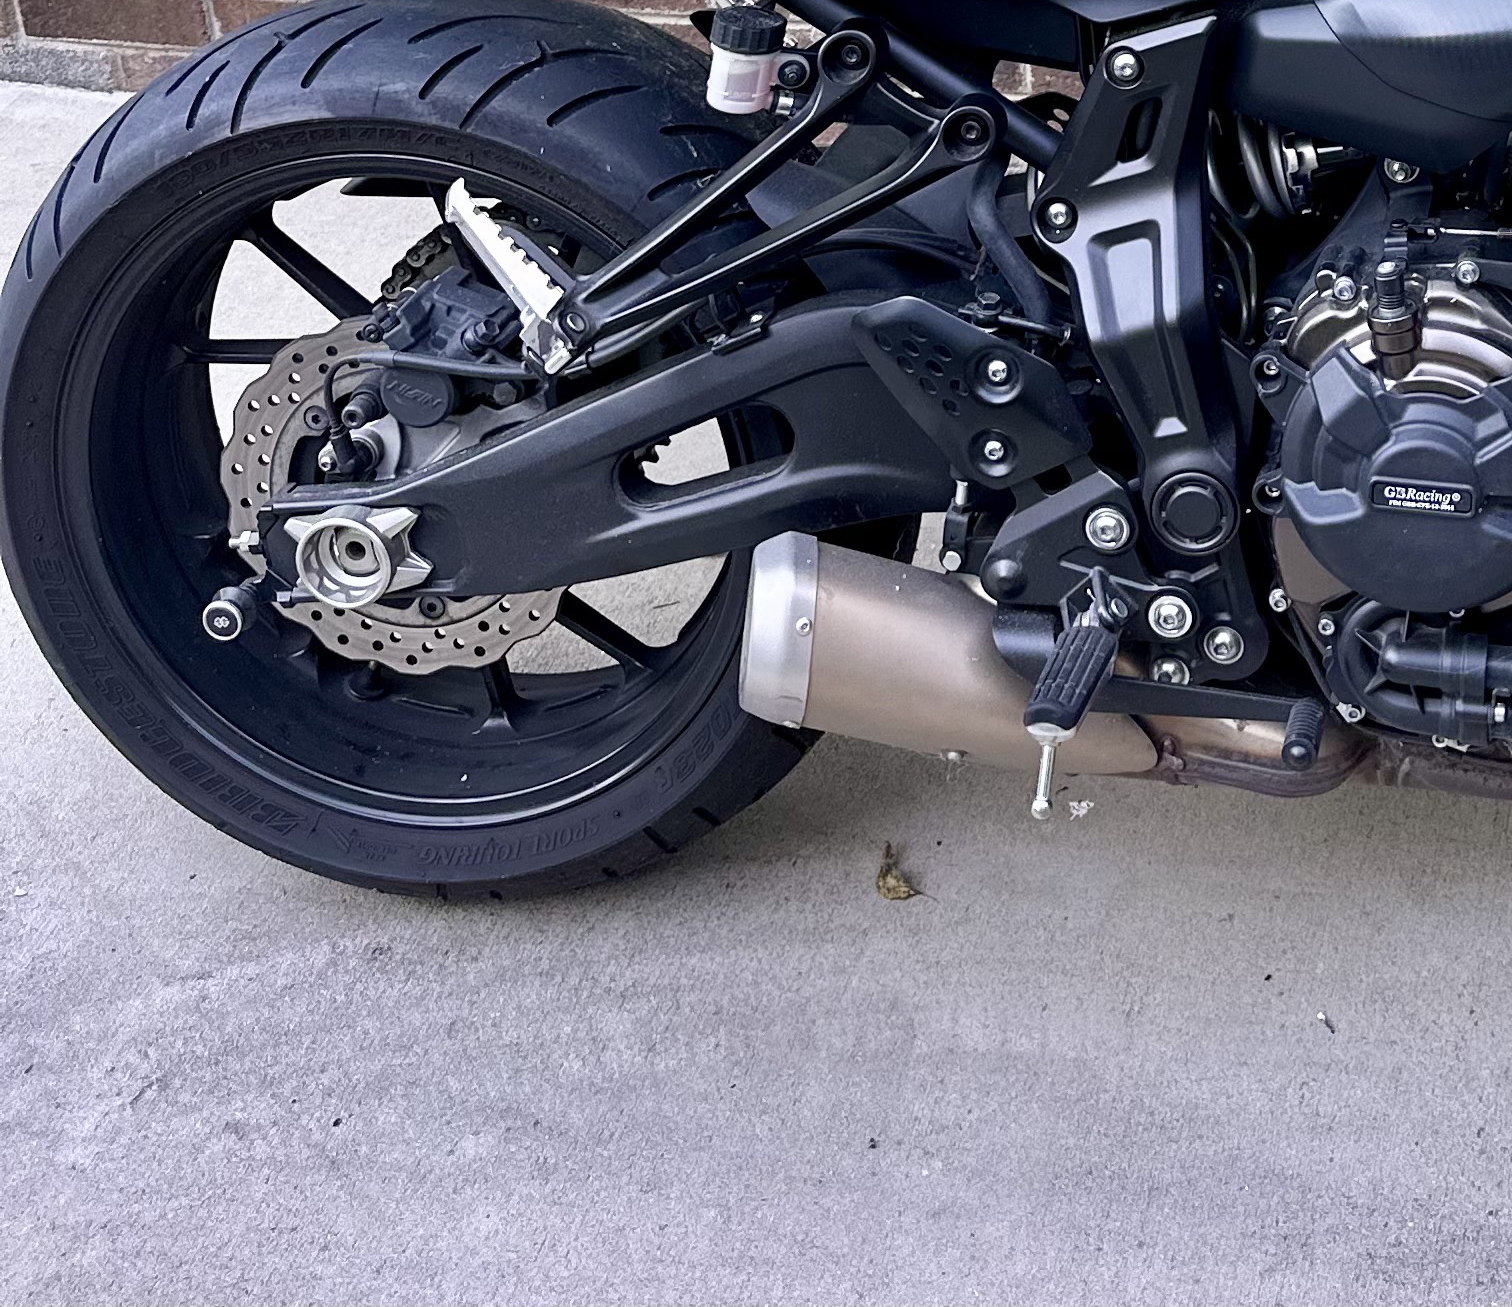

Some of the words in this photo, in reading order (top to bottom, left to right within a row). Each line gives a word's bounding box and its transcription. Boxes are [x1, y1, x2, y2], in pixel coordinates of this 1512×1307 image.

[31, 554, 304, 836] BRIDGESTONE
[534, 815, 602, 853] SPORT
[415, 841, 522, 867] TOURING
